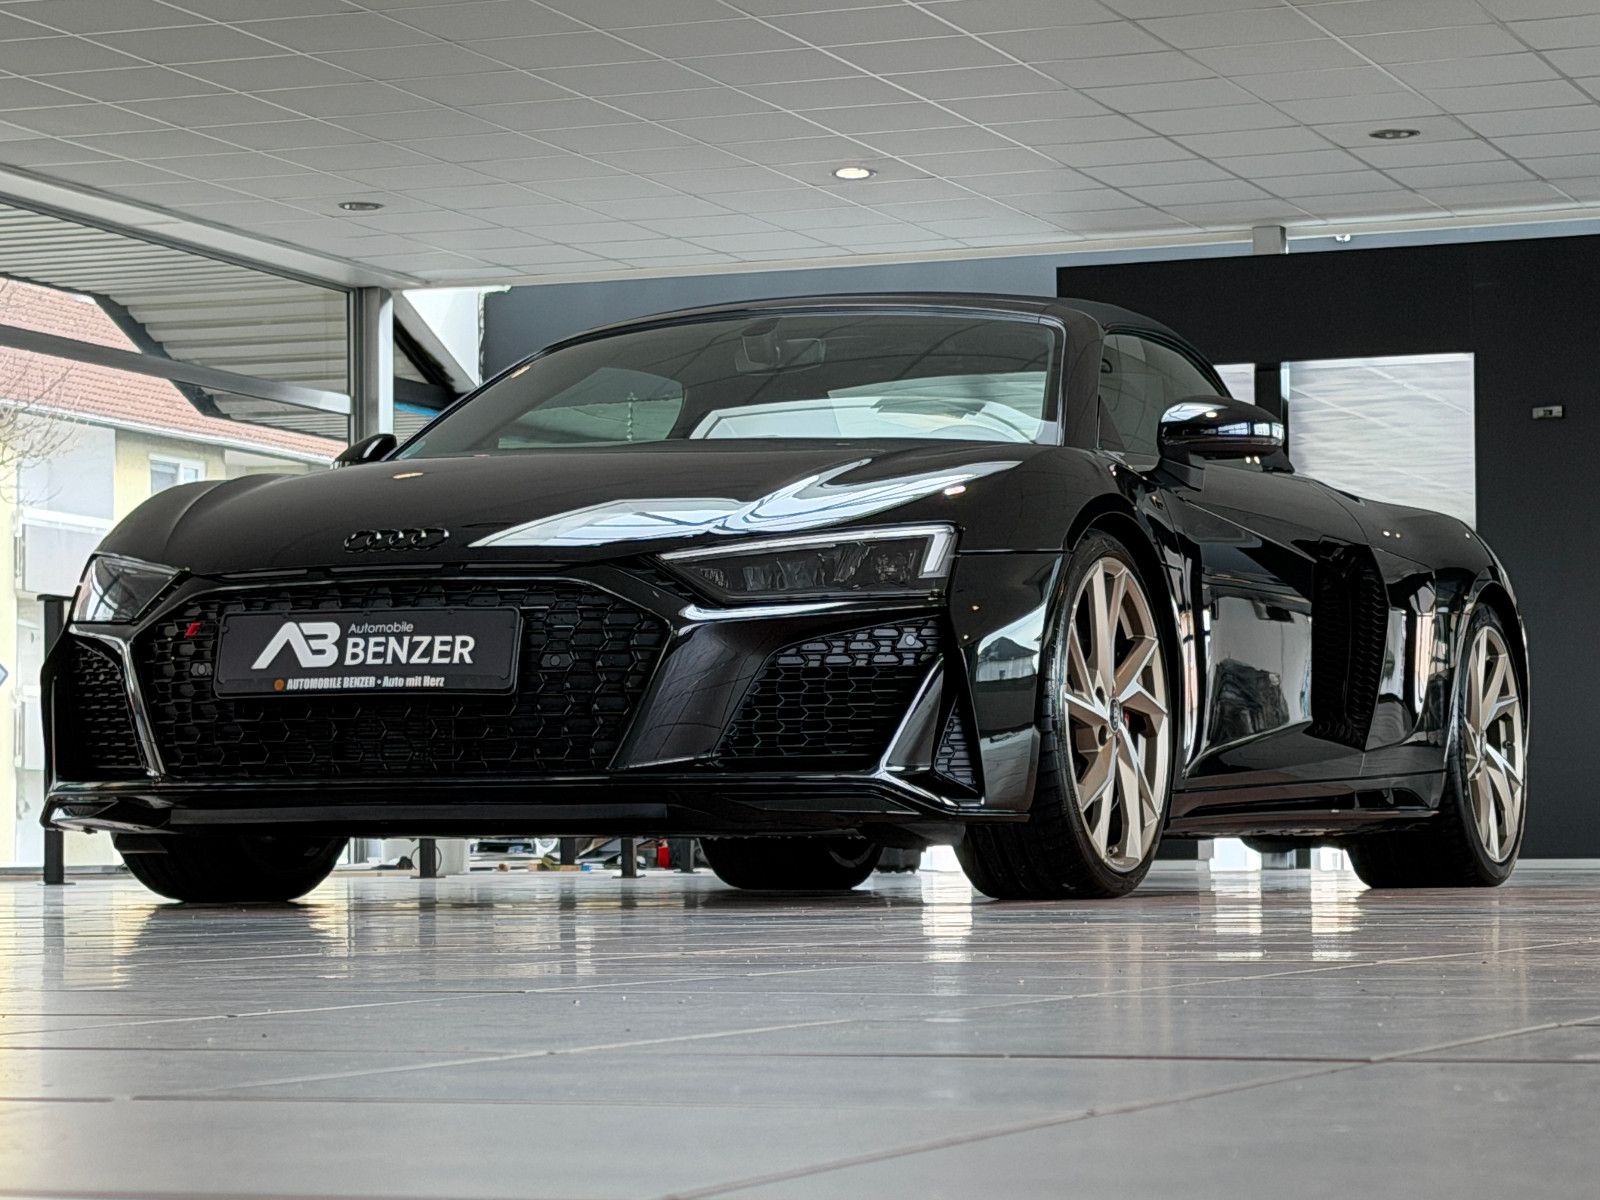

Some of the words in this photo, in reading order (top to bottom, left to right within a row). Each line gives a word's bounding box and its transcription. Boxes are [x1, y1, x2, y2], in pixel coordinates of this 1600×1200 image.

[348, 621, 414, 634] Automobile
[344, 635, 475, 666] BENZER
[286, 678, 342, 690] AUTOMOBILE
[342, 676, 376, 689] BENZER
[382, 675, 404, 688] Auto
[405, 675, 422, 688] mit
[422, 676, 445, 687] Herz
